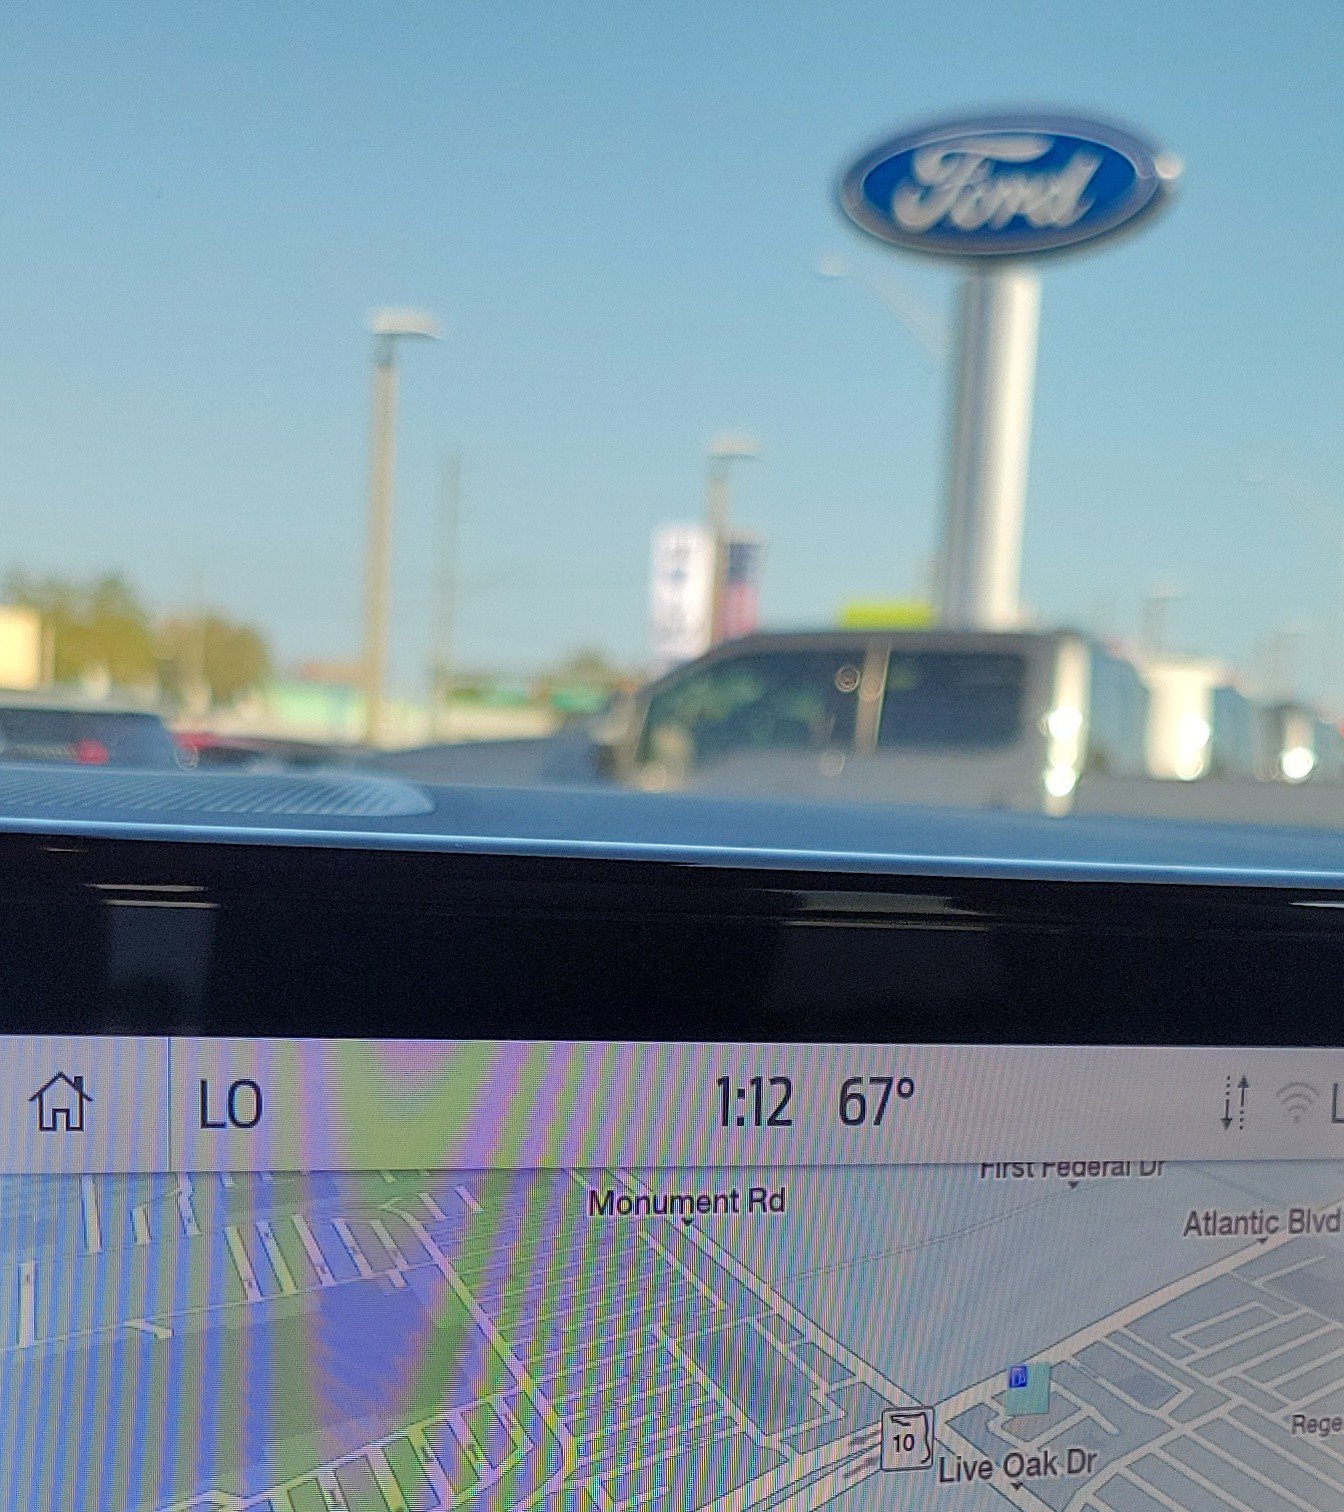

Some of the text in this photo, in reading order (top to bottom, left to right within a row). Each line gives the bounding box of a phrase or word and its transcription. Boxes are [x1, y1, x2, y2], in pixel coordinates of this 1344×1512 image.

[893, 137, 1104, 231] Ford
[199, 1077, 263, 1130] LO
[716, 1075, 794, 1127] 1:12
[838, 1075, 915, 1127] 67°
[980, 1160, 1167, 1179] First Federal Dr
[587, 1186, 787, 1217] Monument Rd
[1182, 1207, 1342, 1238] Atlantic Blvd
[892, 1433, 916, 1453] 10
[937, 1447, 1098, 1484] Live Oak Dr
